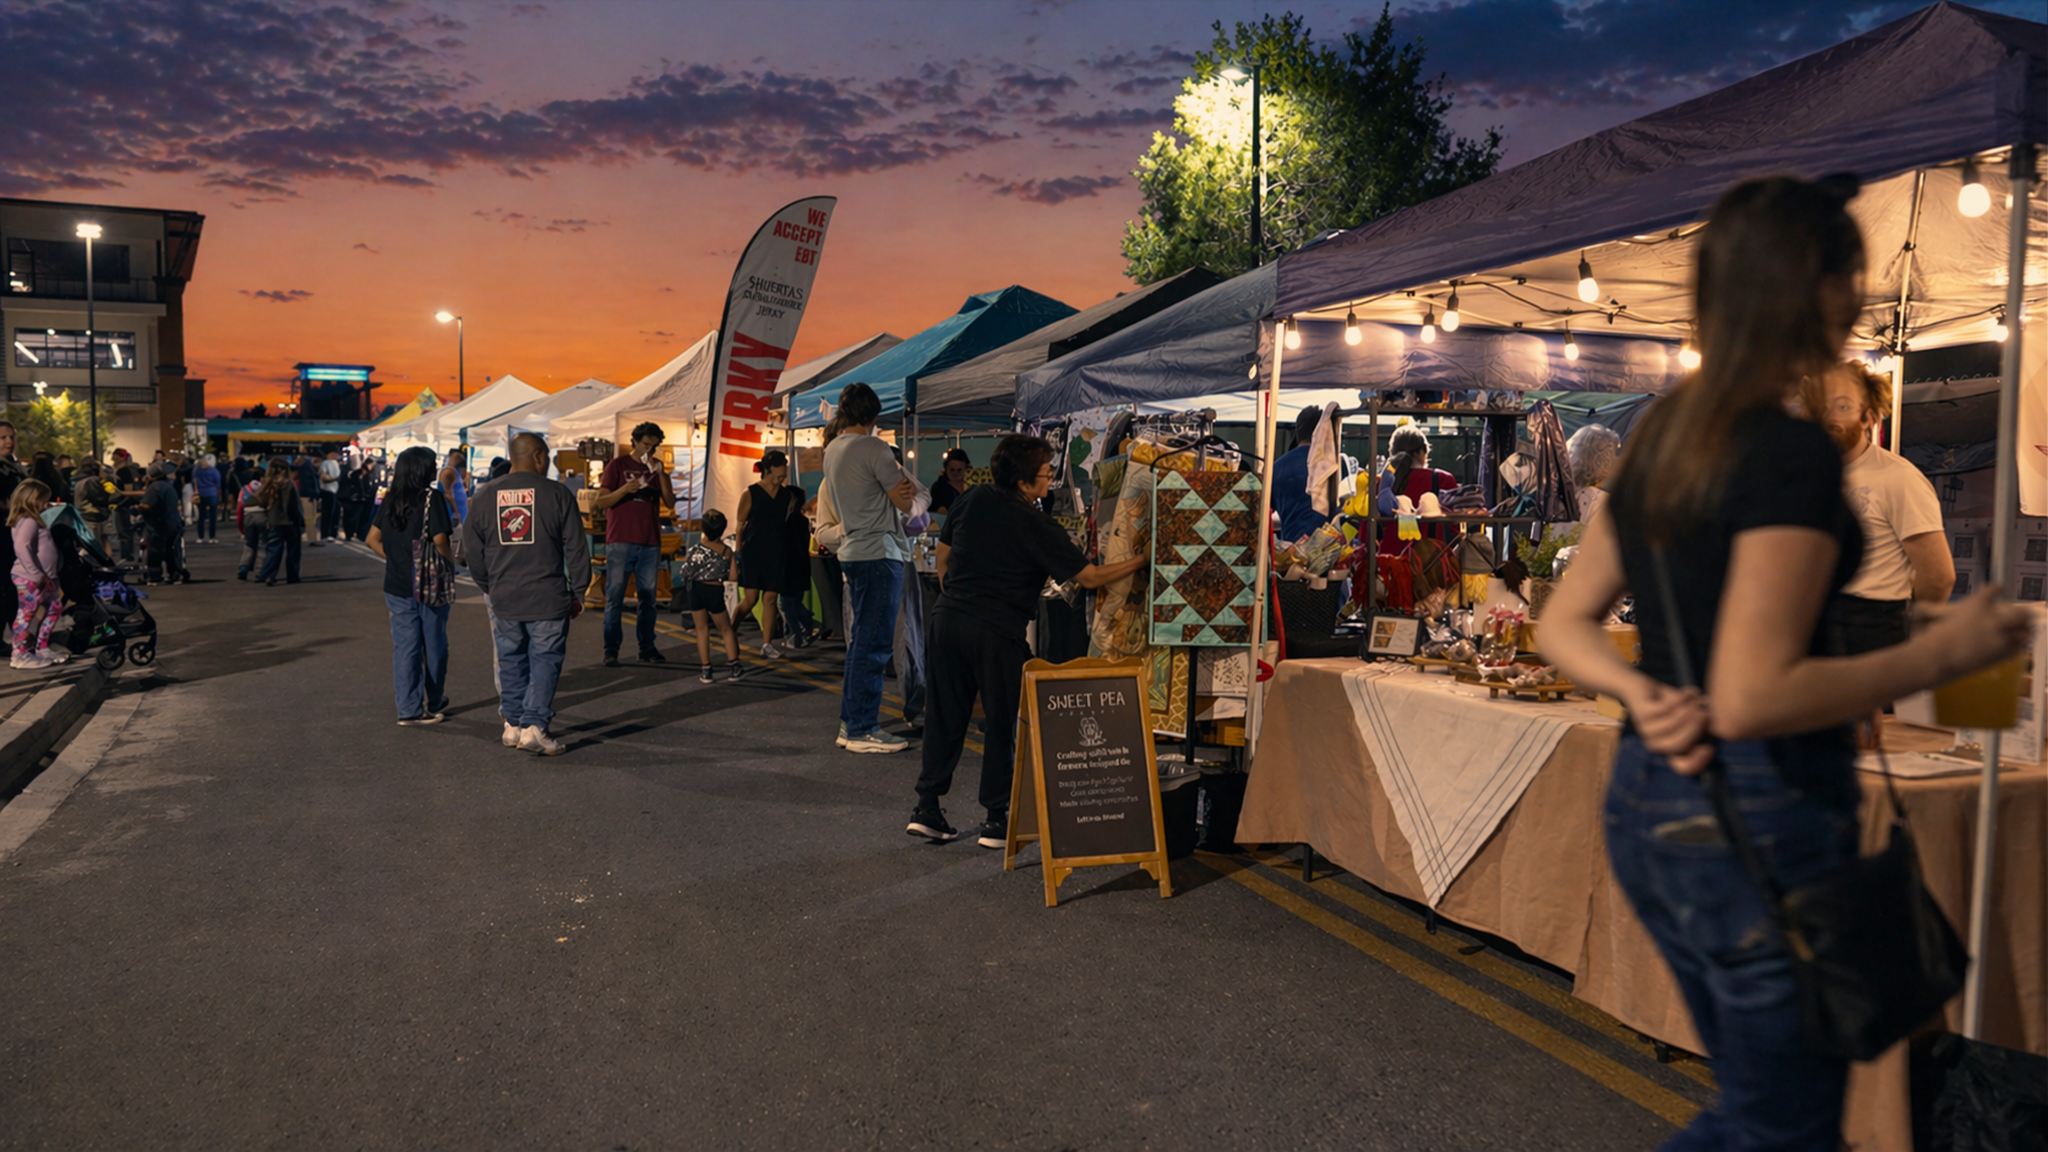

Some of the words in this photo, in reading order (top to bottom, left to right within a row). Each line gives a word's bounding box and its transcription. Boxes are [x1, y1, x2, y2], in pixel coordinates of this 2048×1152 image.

[808, 207, 827, 228] WE
[773, 220, 823, 246] ACCEPT
[794, 246, 818, 266] EBT
[1047, 693, 1092, 711] SWEET
[1100, 691, 1126, 706] PEA
